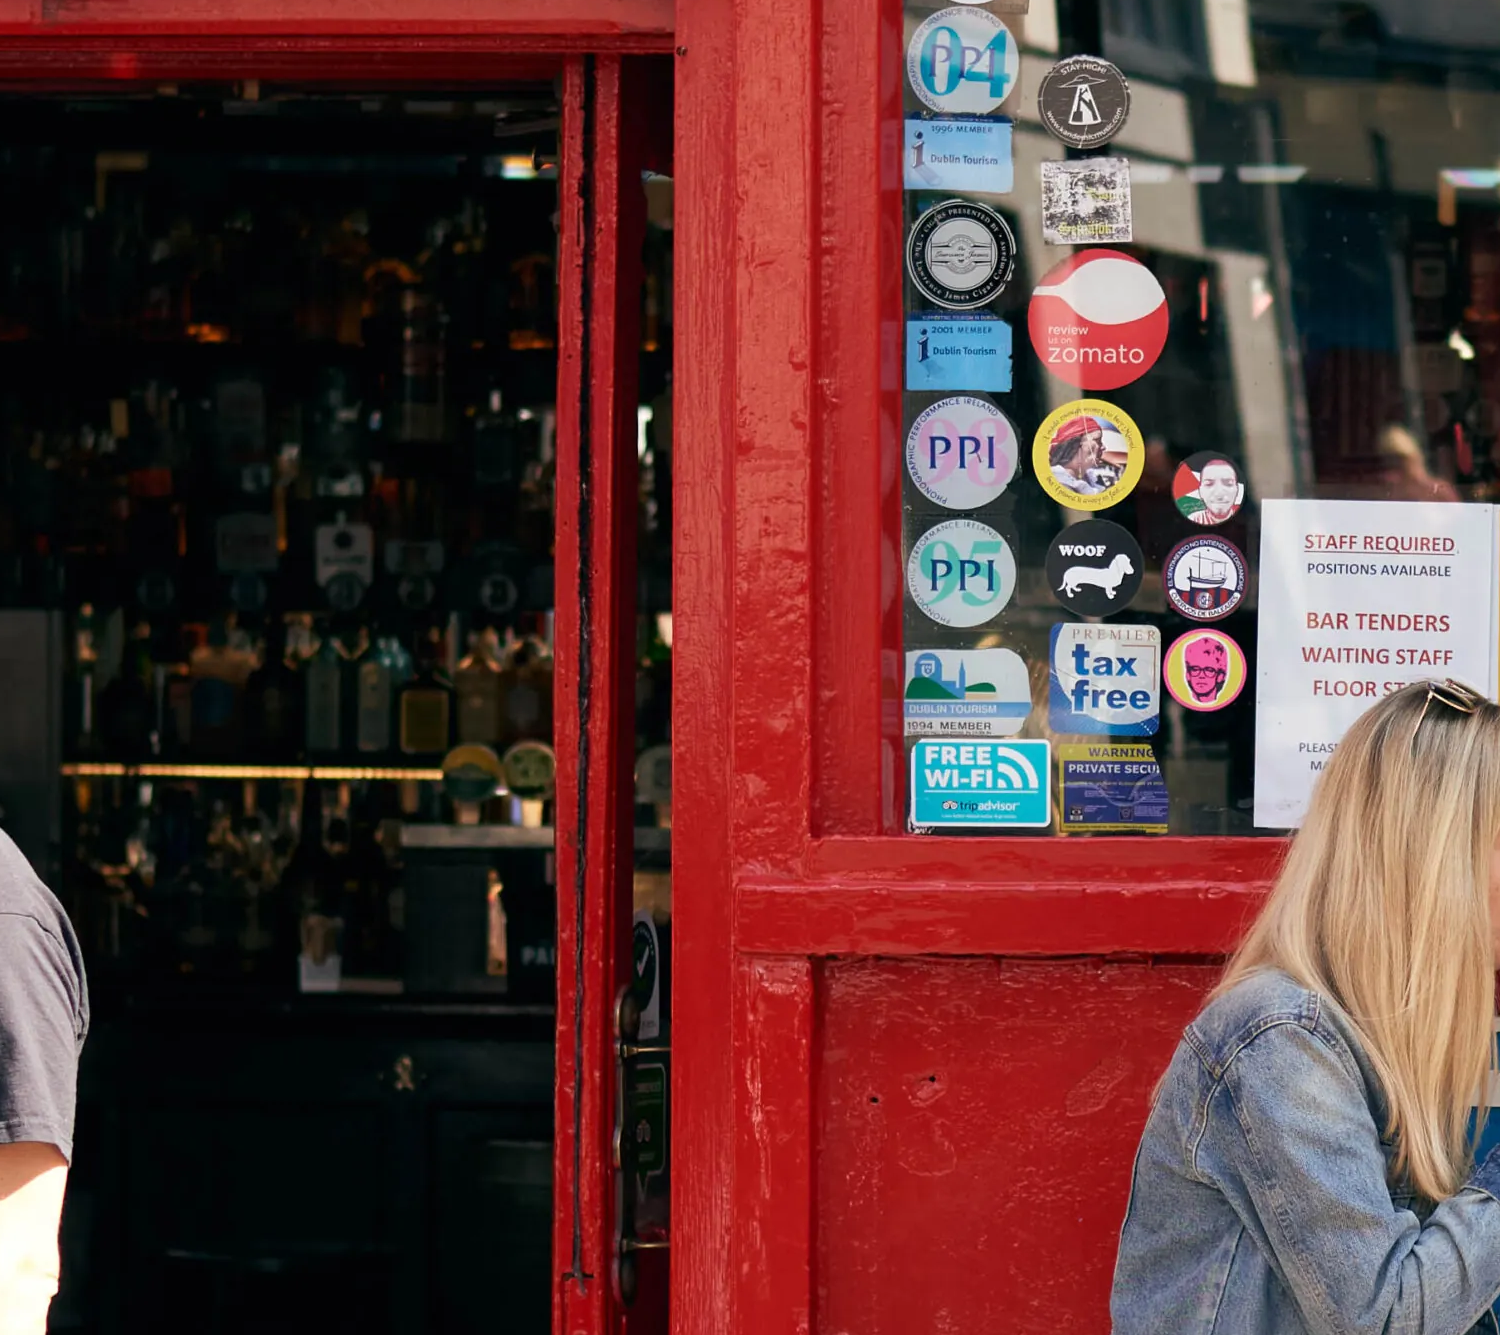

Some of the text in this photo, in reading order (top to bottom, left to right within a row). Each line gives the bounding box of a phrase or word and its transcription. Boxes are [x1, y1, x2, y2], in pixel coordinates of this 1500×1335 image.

[930, 45, 996, 80] PPI
[931, 154, 998, 165] Dublin Tourism
[1048, 325, 1088, 335] review
[933, 346, 997, 355] Dublin Tourism
[1048, 344, 1144, 363] zomato
[929, 436, 995, 469] PPI
[1304, 534, 1357, 550] STAFF
[1059, 545, 1106, 556] WOOF
[931, 560, 995, 591] PPI
[1307, 563, 1451, 577] POSITIONS AVAILABLE
[1306, 613, 1450, 632] BAR TENDERS
[1072, 629, 1156, 640] PREMIER
[1072, 644, 1137, 676] tax
[1302, 647, 1453, 665] WAITING STAFF
[1071, 680, 1150, 713] free
[1313, 680, 1376, 697] FLOOR
[909, 704, 997, 713] DUBLIN TOURISM
[940, 721, 991, 730] MEMBER
[925, 746, 991, 765] FREE
[1068, 764, 1121, 774] PRIVATE
[925, 769, 991, 788] WI-FI
[959, 800, 1018, 812] tripadvisor
